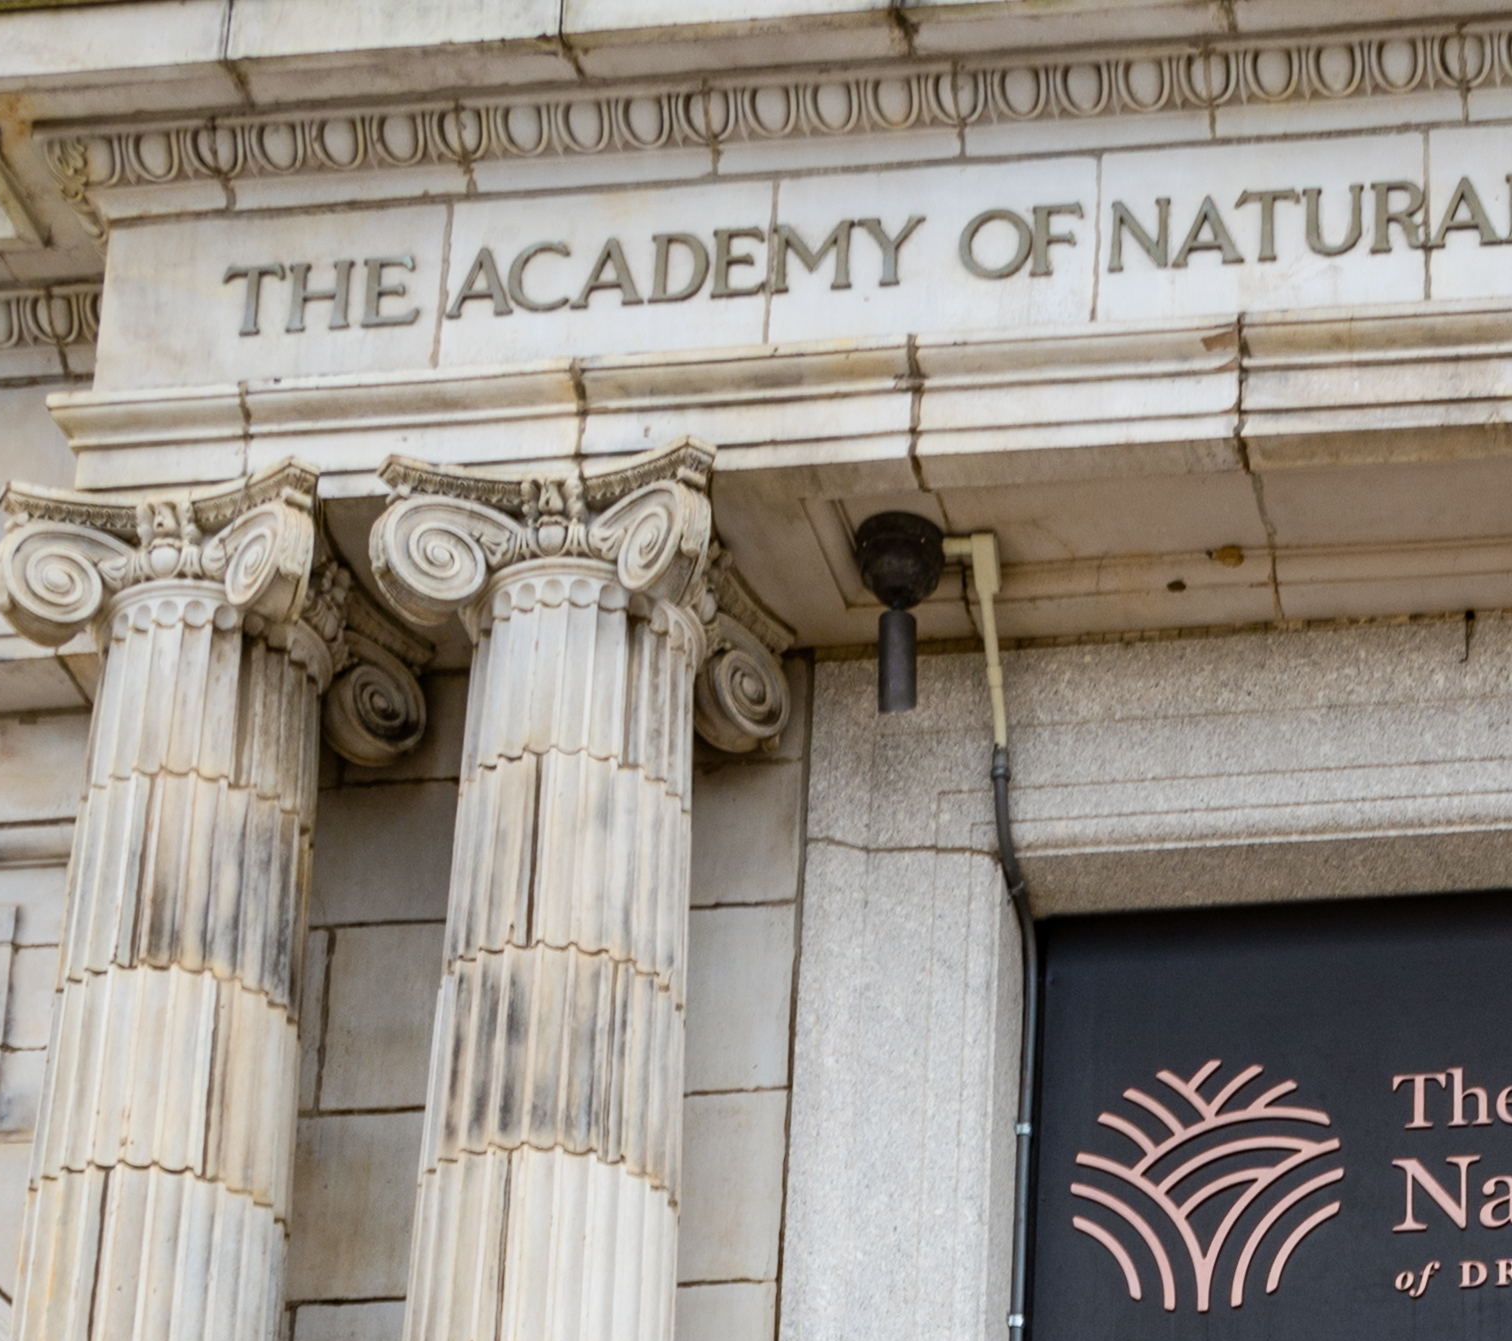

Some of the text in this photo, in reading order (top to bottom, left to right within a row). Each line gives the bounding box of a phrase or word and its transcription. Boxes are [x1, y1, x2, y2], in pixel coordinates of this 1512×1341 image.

[223, 255, 421, 336] THE
[446, 214, 925, 320] ACADEMY
[959, 201, 1084, 280] OF
[1394, 1259, 1440, 1296] of
